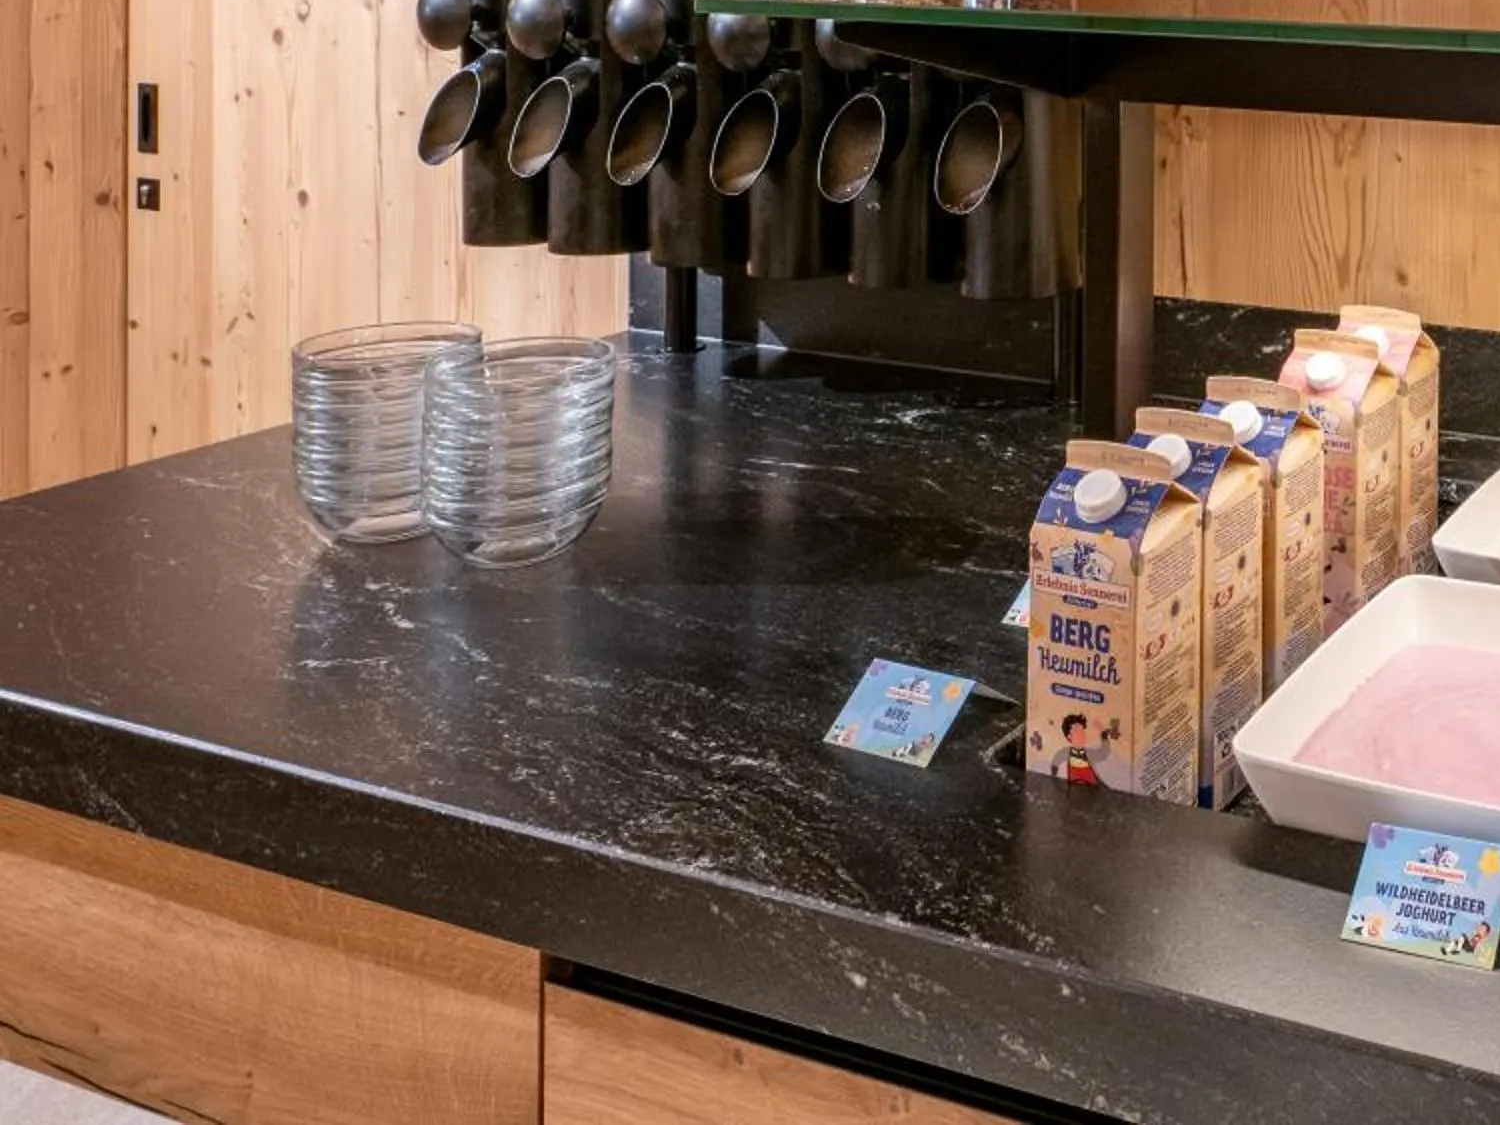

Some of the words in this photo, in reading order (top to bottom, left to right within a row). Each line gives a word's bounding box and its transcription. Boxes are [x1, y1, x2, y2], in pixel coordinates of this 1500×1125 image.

[1049, 612, 1111, 654] BERG
[1037, 644, 1122, 686] Heumilch
[1375, 881, 1486, 916] WILDHEIDELBEER
[1395, 902, 1457, 926] JOGHURT
